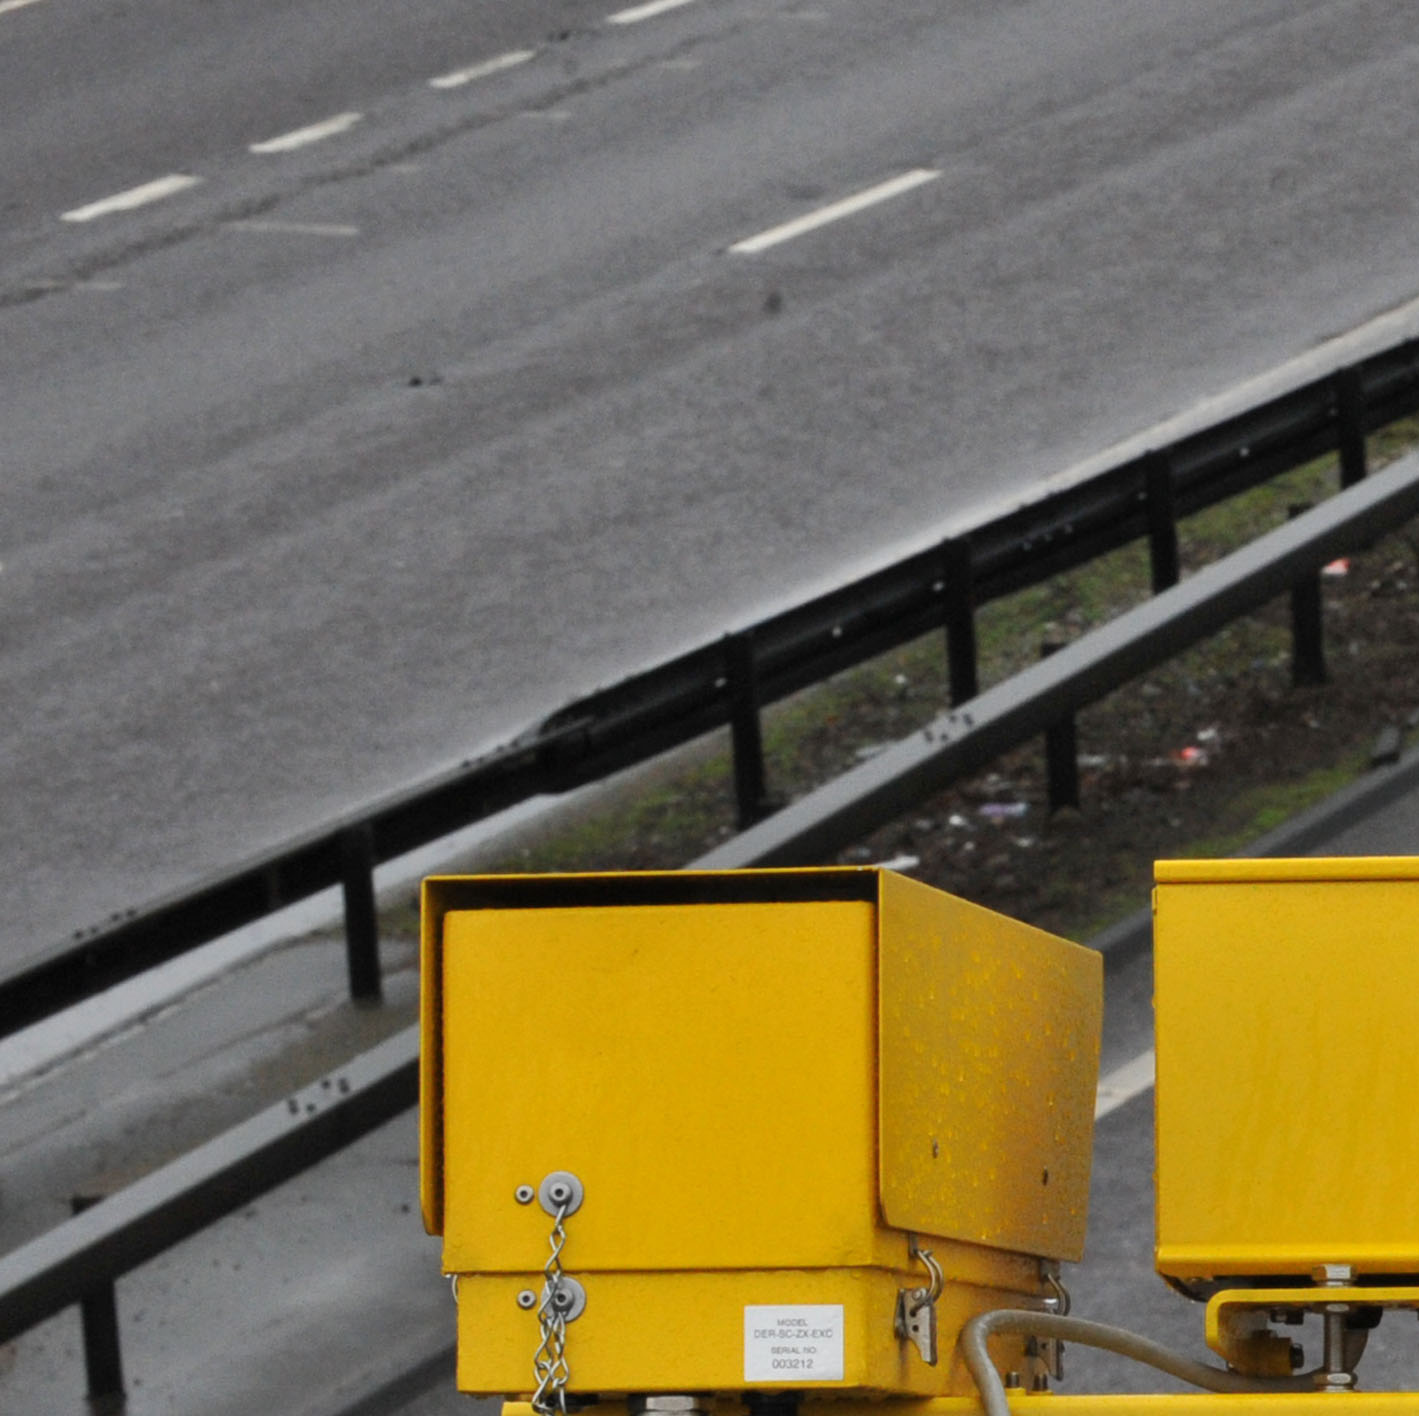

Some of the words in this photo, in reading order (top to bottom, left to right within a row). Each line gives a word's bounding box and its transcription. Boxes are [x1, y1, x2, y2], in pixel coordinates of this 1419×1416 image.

[777, 1318, 808, 1327] MODEL
[771, 1346, 800, 1354] SERIAL
[772, 1358, 814, 1369] 003212
